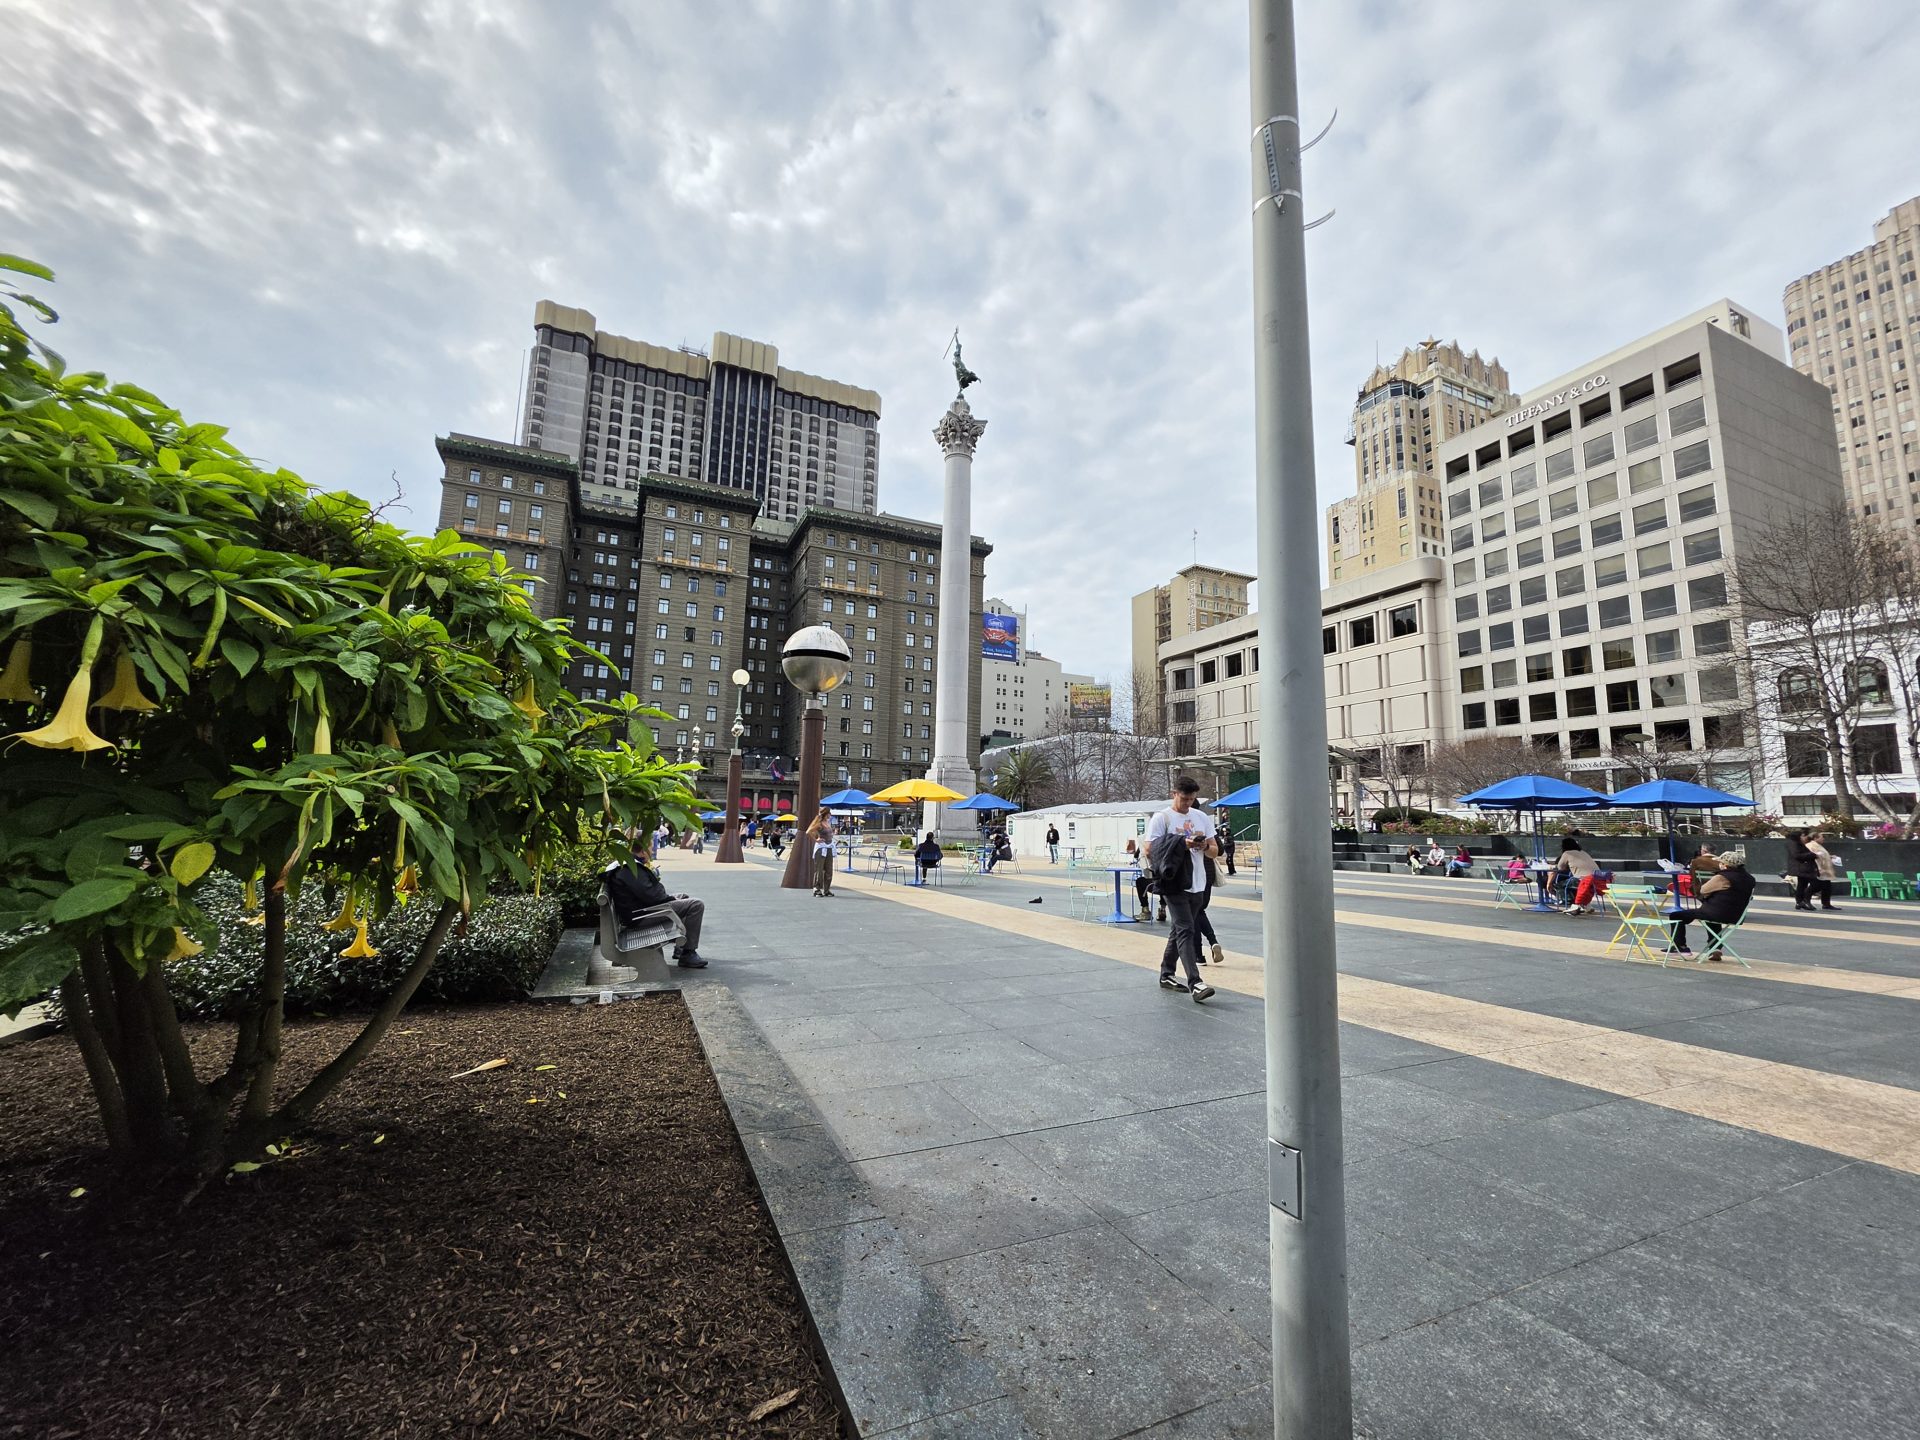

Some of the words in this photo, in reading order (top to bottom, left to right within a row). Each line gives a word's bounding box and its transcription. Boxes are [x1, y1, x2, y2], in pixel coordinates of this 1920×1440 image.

[1505, 391, 1567, 427] TIFFANY
[1570, 387, 1581, 399] &
[1583, 374, 1610, 392] CO.
